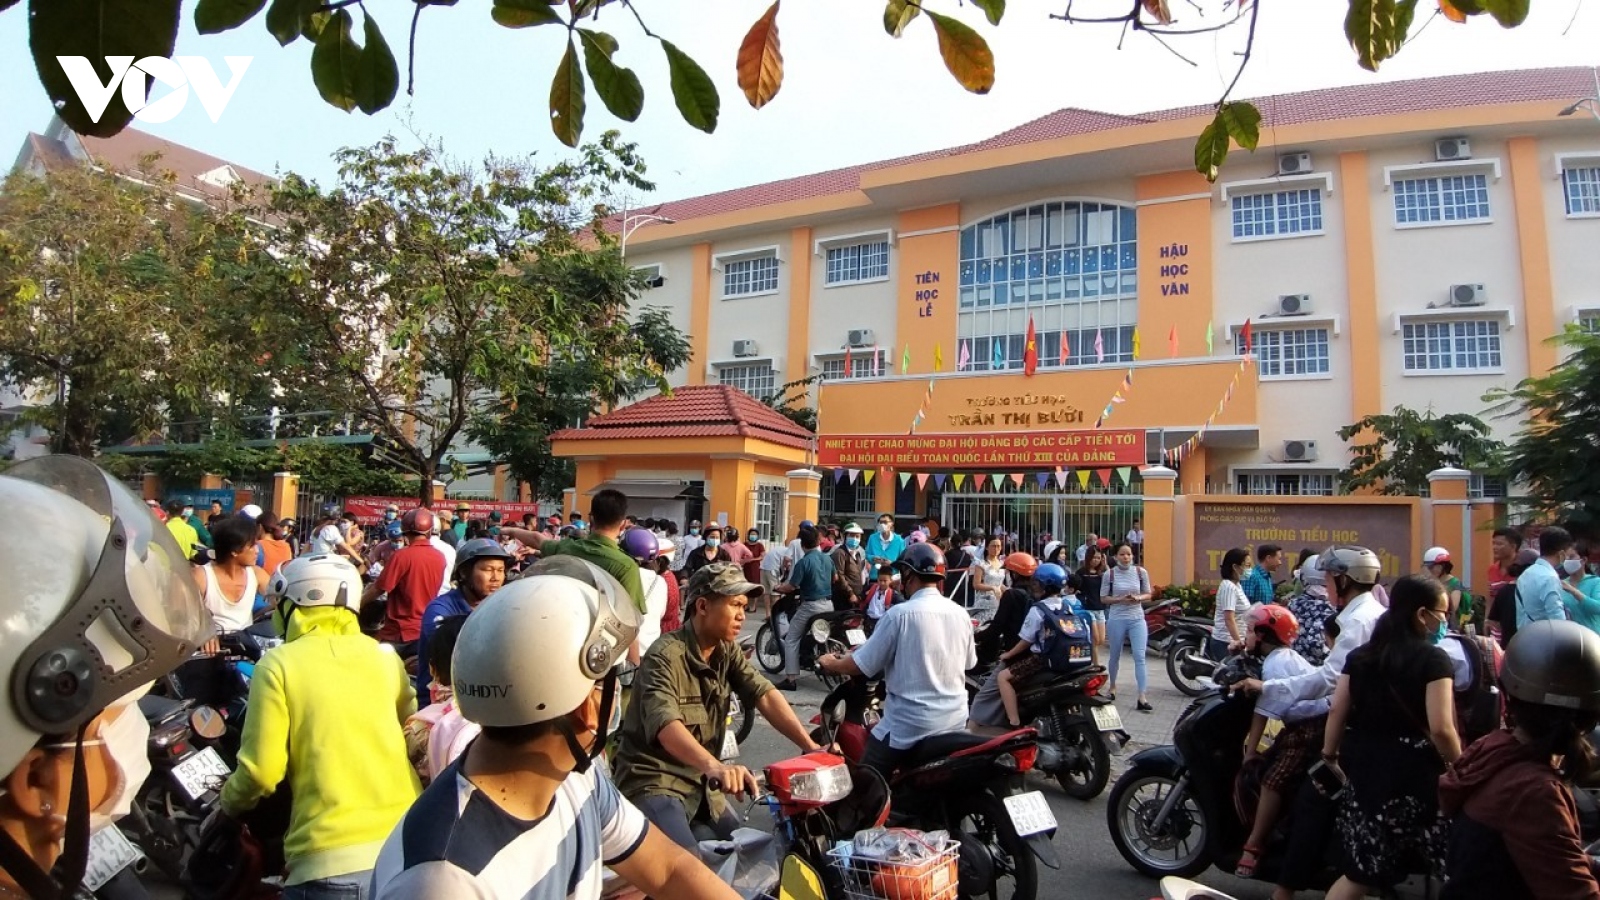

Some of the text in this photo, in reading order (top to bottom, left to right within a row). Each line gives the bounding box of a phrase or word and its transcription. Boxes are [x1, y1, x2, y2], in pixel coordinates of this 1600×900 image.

[1160, 242, 1188, 260] HẬU
[915, 270, 940, 285] TIÊN
[1160, 264, 1189, 279] HỌC
[916, 290, 938, 302] HỌC
[1160, 282, 1189, 296] VĂN
[948, 406, 1084, 427] TRẦN THỊ BƯỞI
[825, 438, 852, 450] NHIỆT
[855, 438, 876, 450] LIỆT
[939, 438, 956, 450] ĐẠI
[960, 436, 978, 449] HỘI
[981, 435, 1010, 447] ĐẢNG
[1014, 435, 1029, 448] BỘ
[1032, 435, 1055, 446] CÁC
[1058, 433, 1081, 446] CẤP
[1085, 432, 1112, 446] TIẾN
[1116, 434, 1136, 444] TỚI
[840, 454, 856, 464] ĐẠI
[858, 452, 874, 464] HỘI
[877, 454, 893, 464] ĐẠI
[896, 450, 920, 462] BIỂU
[952, 450, 980, 464] QUỐC
[1008, 451, 1031, 462] THỨ
[1034, 452, 1053, 462] XIII
[1056, 448, 1079, 462] CỦA
[1084, 449, 1116, 461] ĐẢNG
[1245, 525, 1359, 544] TRƯỜNG TIỂU HỌC
